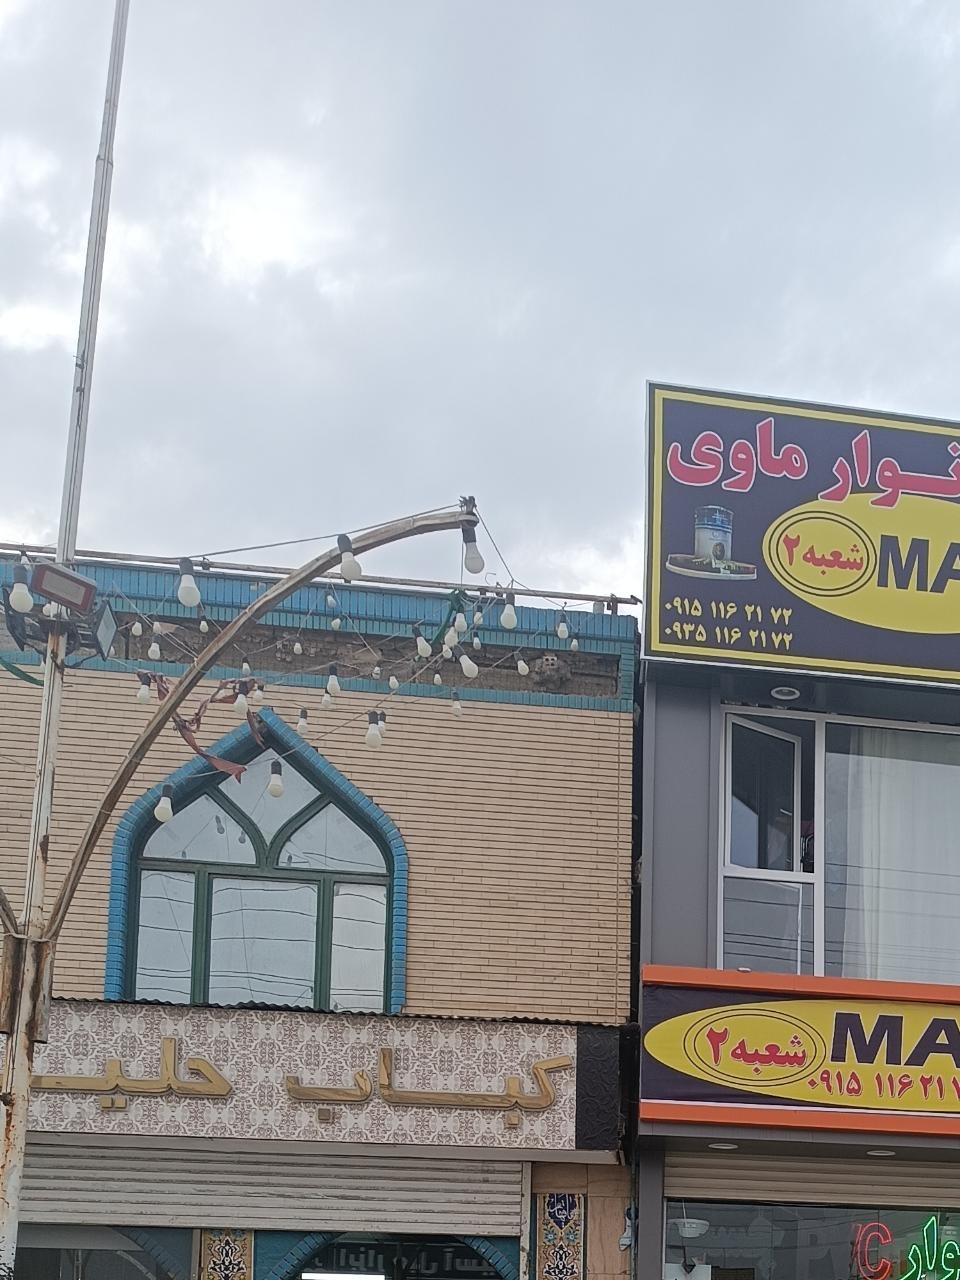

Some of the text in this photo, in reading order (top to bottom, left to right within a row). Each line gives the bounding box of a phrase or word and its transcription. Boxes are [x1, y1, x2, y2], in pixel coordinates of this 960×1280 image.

[667, 417, 808, 493] ماوی
[781, 533, 865, 577] شعبه ۲
[664, 596, 793, 626] ۰۹۱۵ ۱۱۶ ۲۱ ۷۲
[664, 621, 707, 642] ۰۹۳۵
[715, 625, 742, 645] ۱۱۶
[705, 1025, 807, 1077] شعبه ۲
[30, 1036, 574, 1125] کباب حلی
[807, 1068, 864, 1097] ۰۹۱۵
[874, 1072, 915, 1098] ۱۱۶
